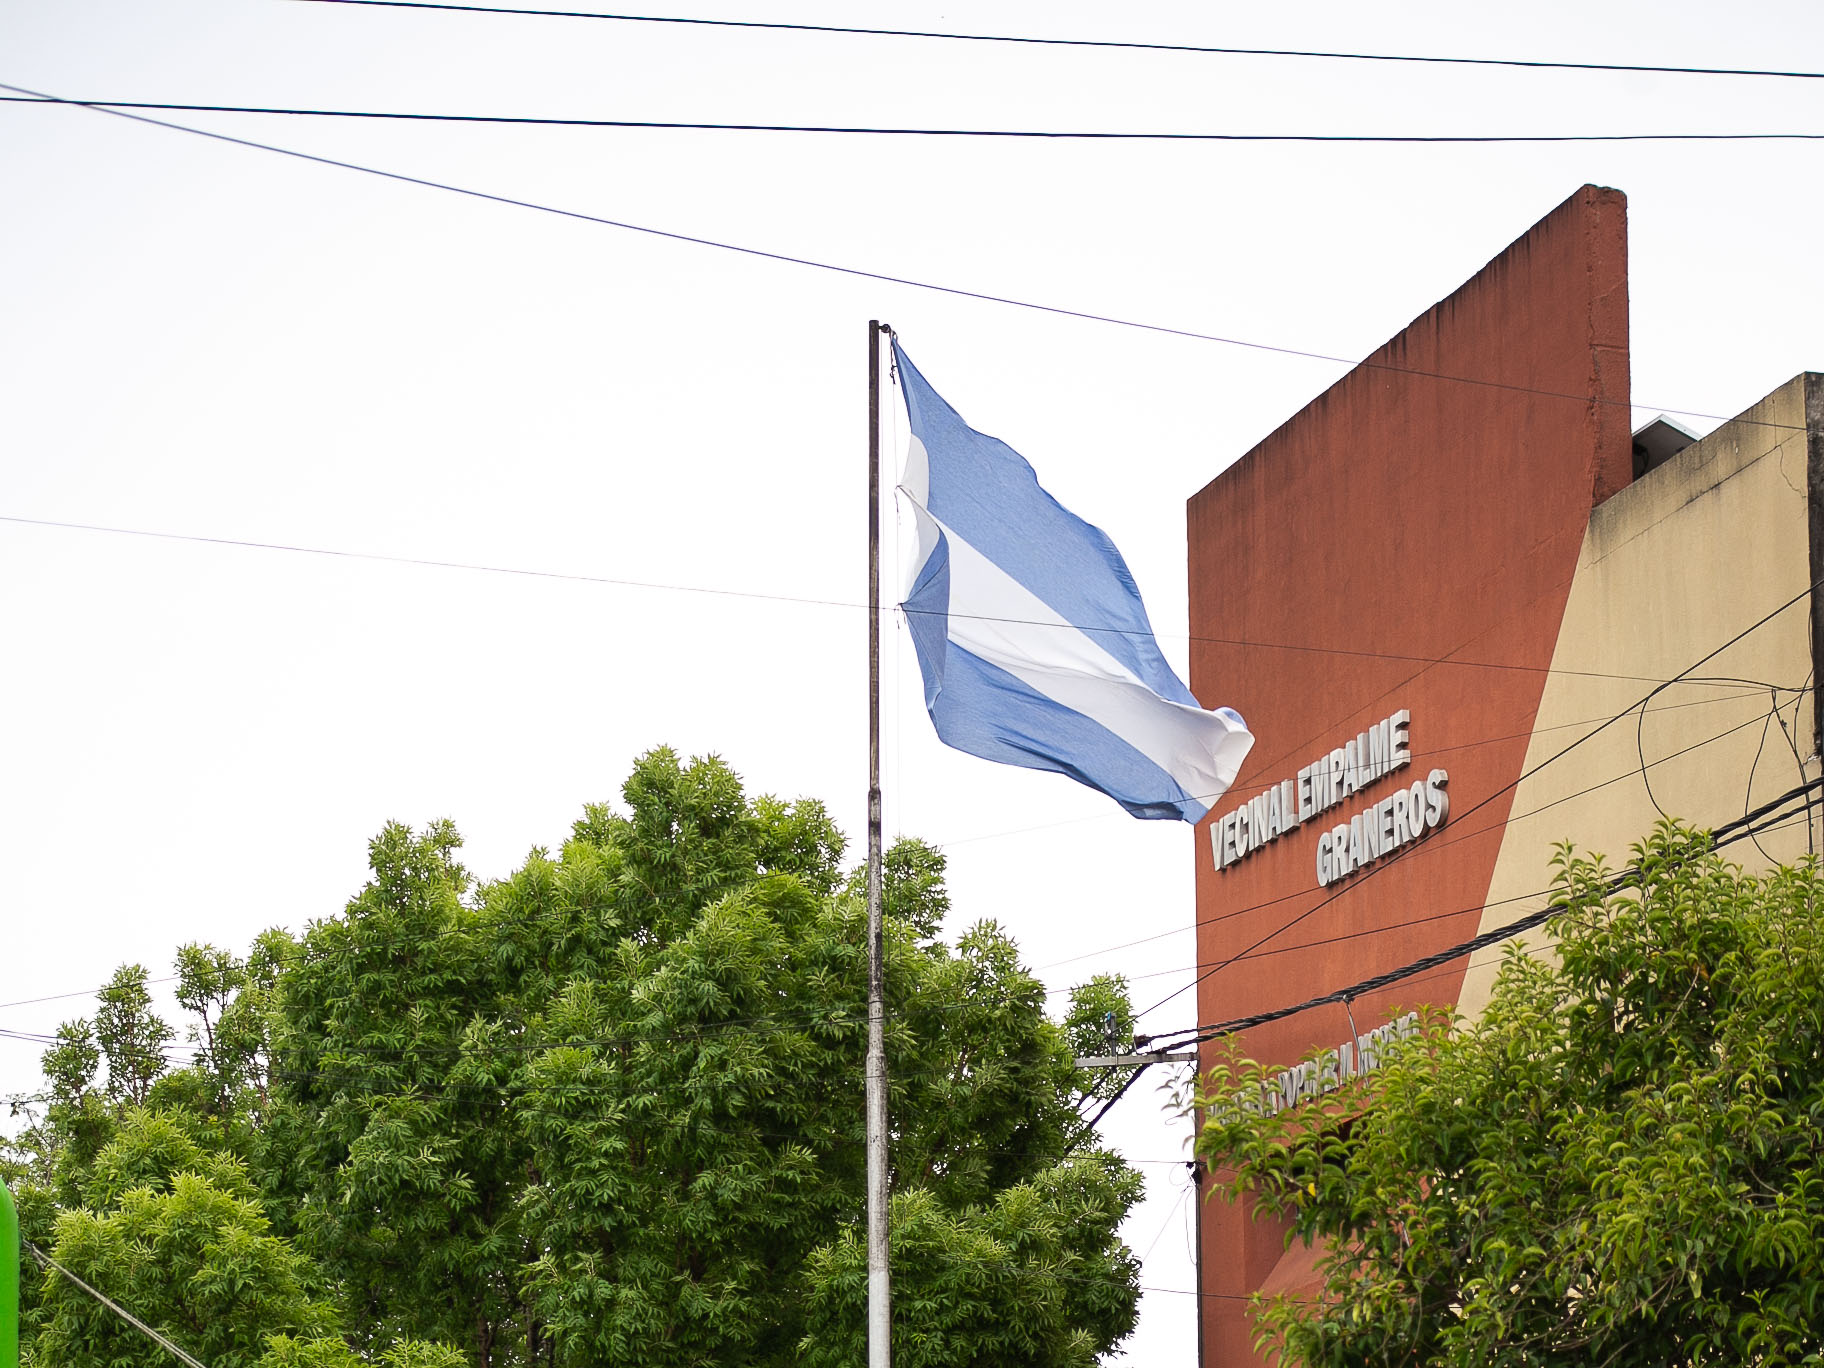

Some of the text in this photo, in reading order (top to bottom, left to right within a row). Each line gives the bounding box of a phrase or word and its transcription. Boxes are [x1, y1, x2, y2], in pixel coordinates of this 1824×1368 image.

[1209, 709, 1411, 873] VECINAL EMPALME
[1316, 768, 1449, 888] GRANEROS
